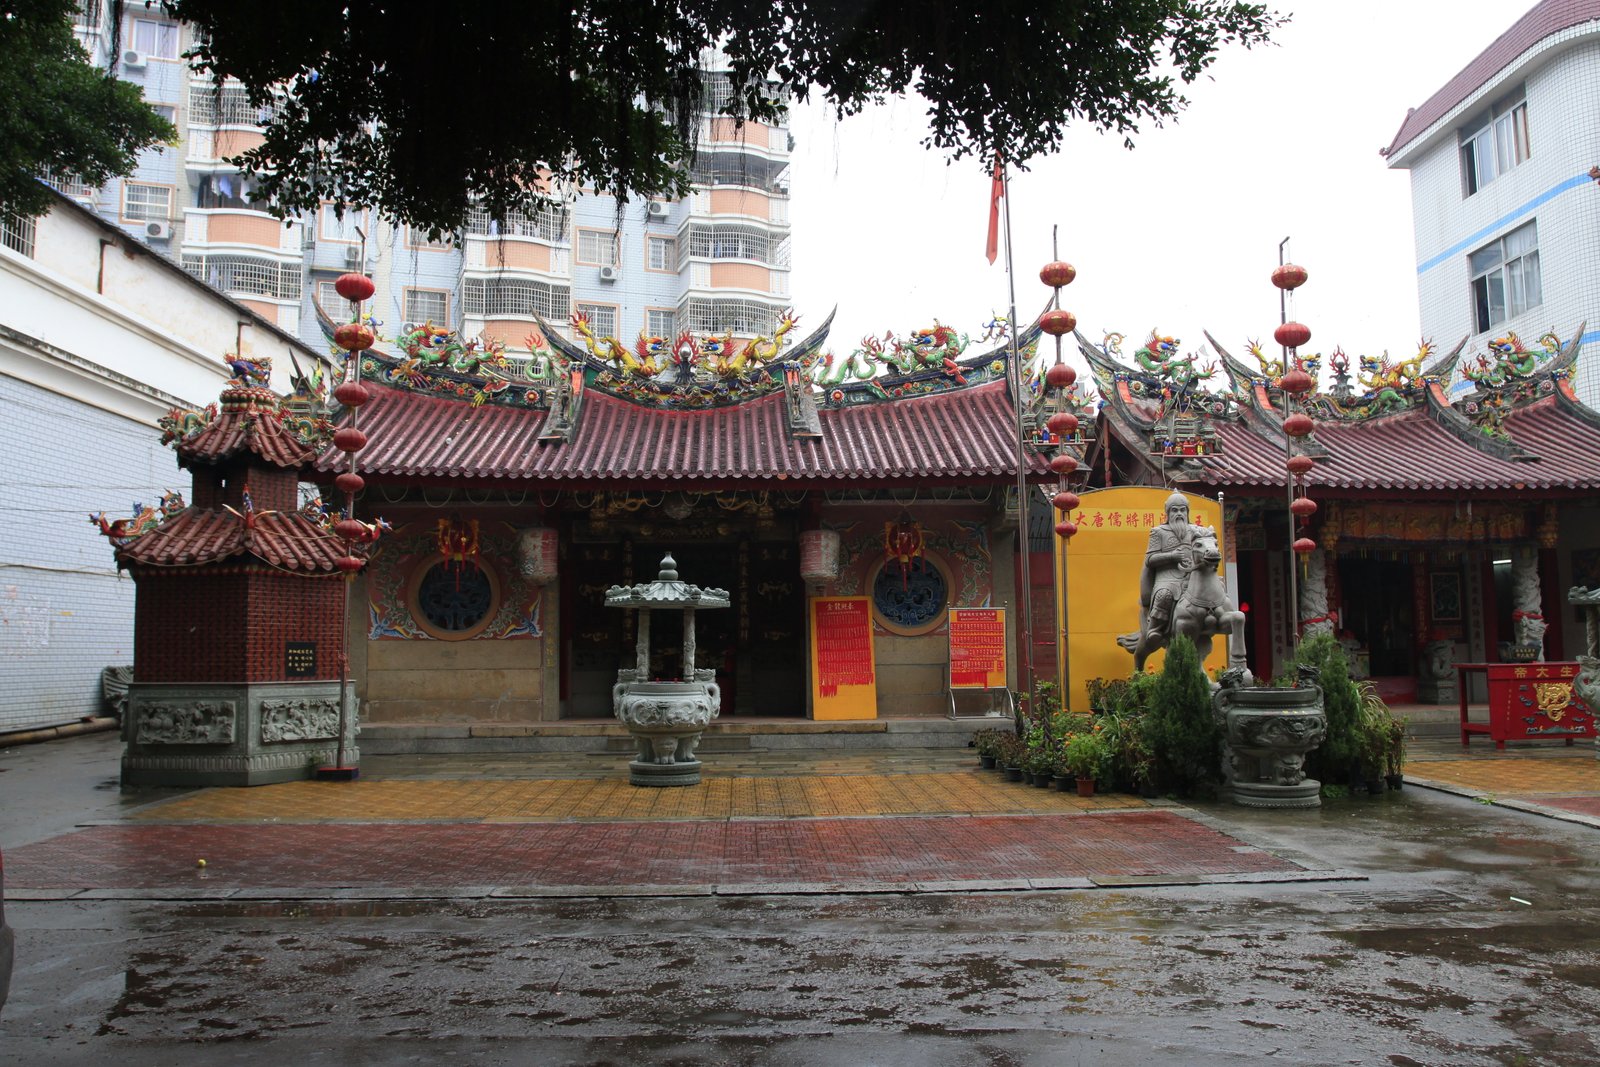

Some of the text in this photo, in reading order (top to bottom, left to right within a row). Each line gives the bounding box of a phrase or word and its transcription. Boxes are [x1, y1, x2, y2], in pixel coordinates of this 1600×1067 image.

[1075, 511, 1204, 528] 大唐儒將開王
